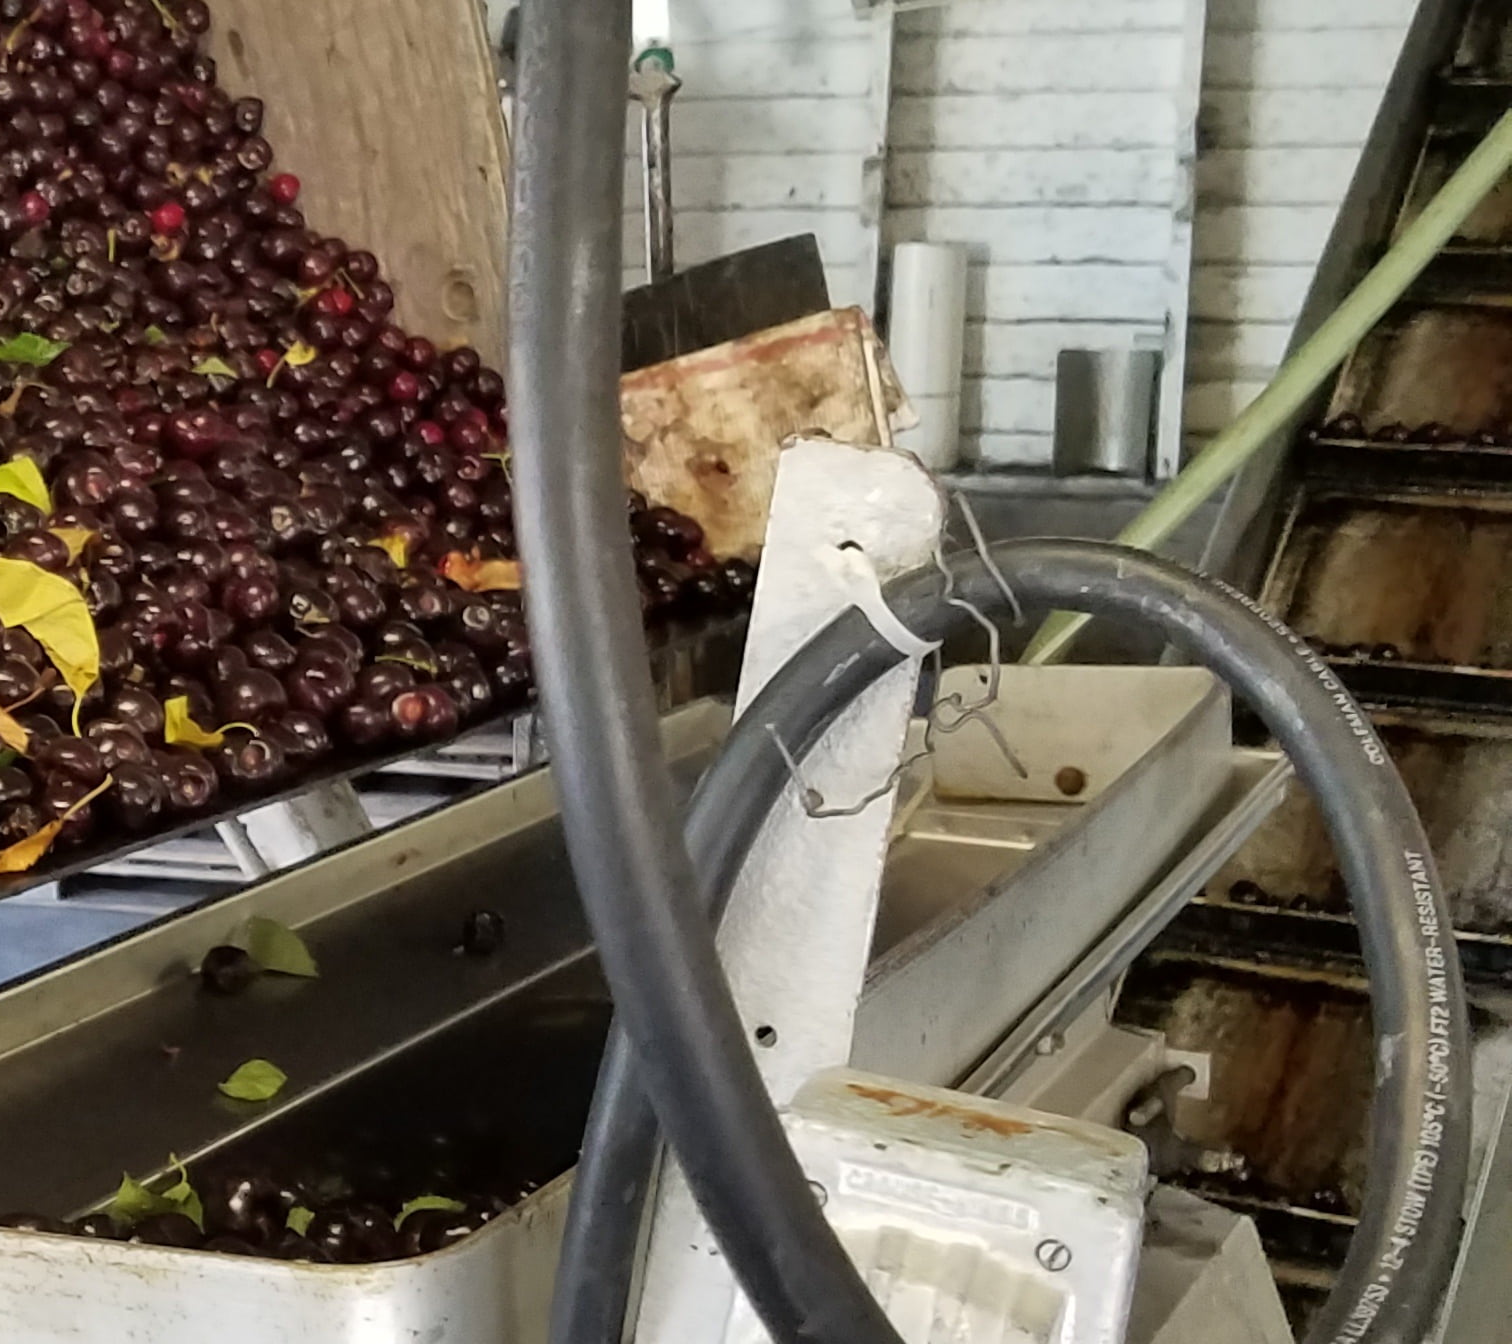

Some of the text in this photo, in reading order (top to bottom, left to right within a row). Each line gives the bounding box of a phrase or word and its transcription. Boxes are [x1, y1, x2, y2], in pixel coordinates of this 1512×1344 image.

[1404, 849, 1448, 1004] WATER-RESISTANT
[1430, 1005, 1451, 1036] FT2
[1406, 1149, 1439, 1192] (TPE)
